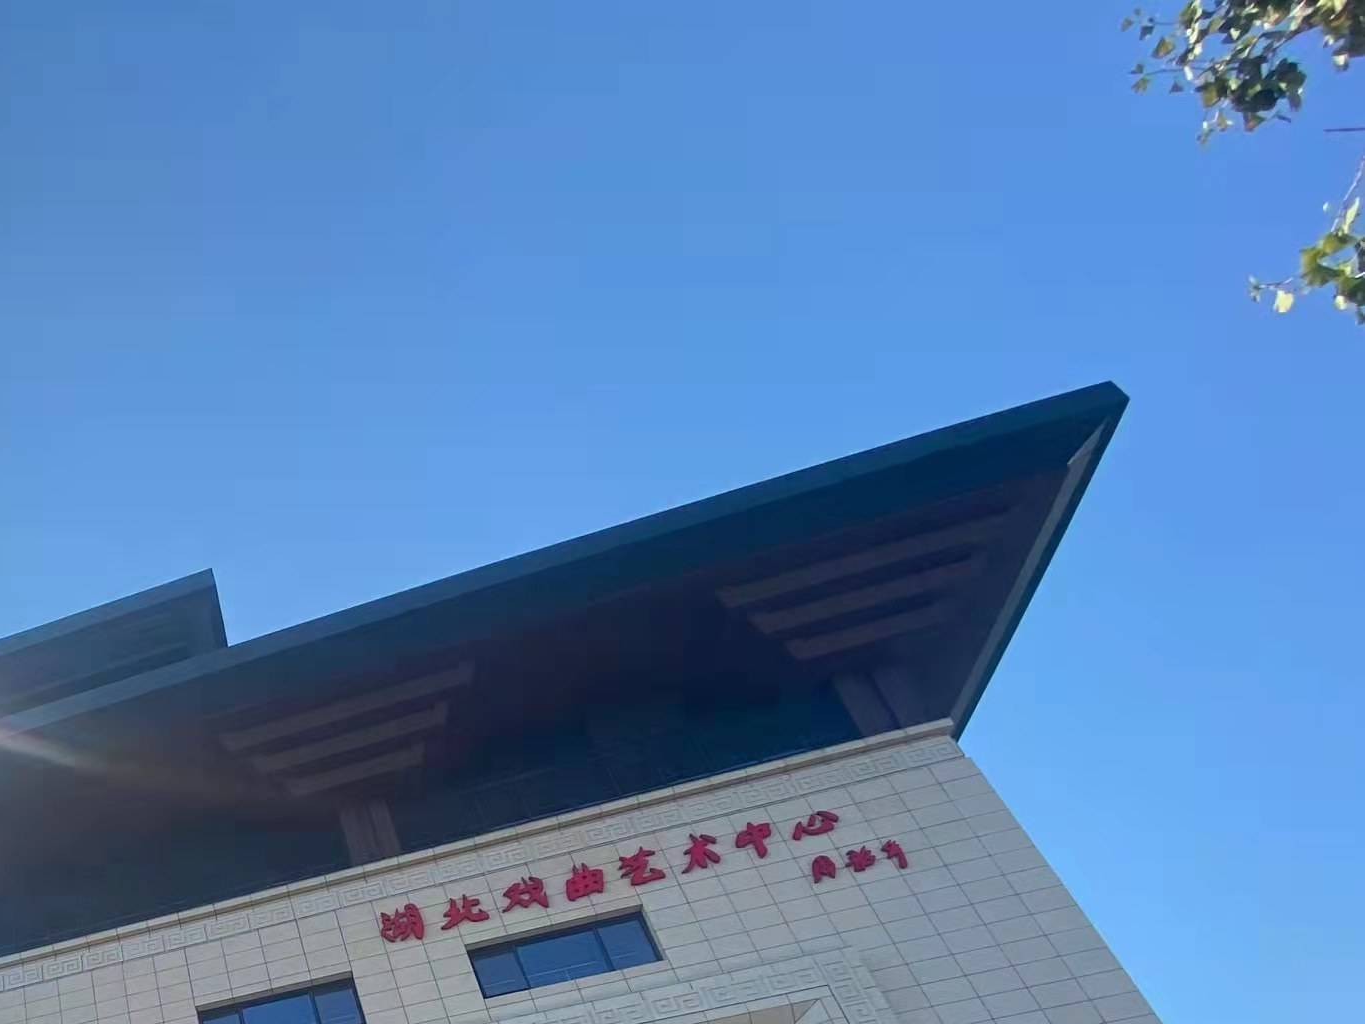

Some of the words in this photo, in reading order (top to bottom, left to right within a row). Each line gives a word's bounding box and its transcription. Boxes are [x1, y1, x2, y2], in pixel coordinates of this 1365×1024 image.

[380, 810, 840, 943] 湖北戏曲艺术中心
